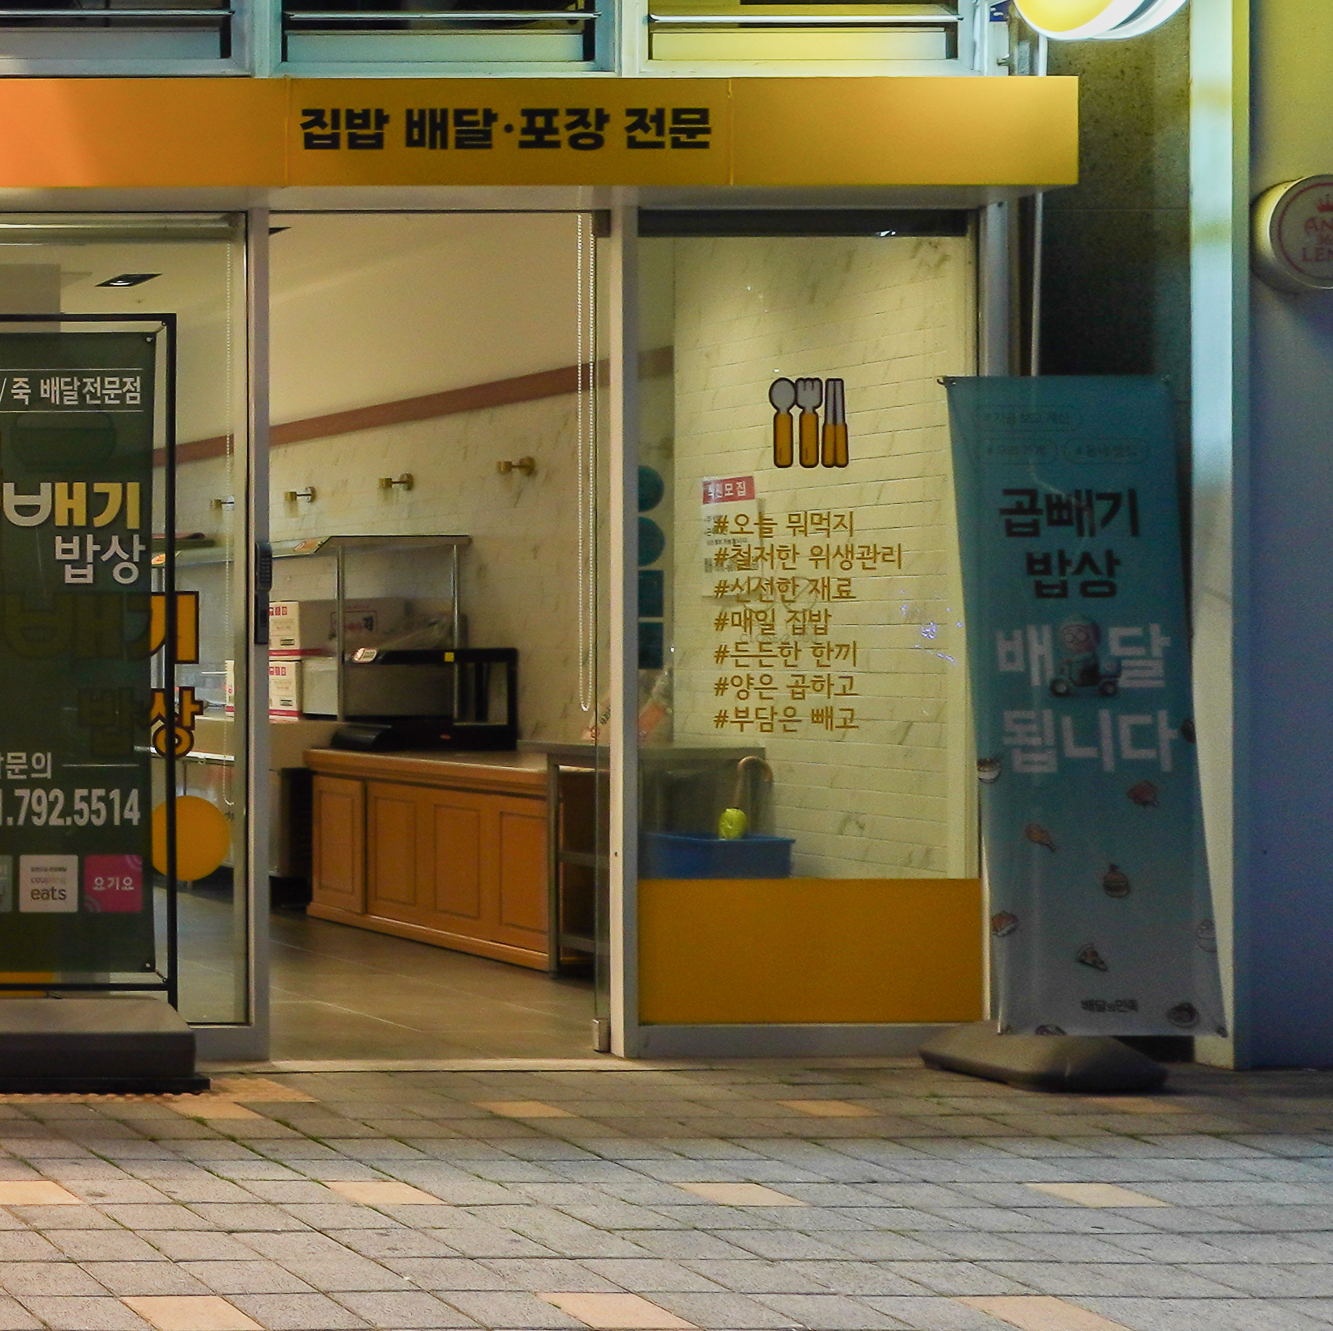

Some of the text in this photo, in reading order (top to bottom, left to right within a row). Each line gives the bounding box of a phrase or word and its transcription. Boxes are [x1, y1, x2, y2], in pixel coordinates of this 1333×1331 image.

[299, 106, 389, 151] 집밥
[624, 106, 714, 151] 전문
[54, 534, 146, 585] 밥상
[808, 543, 903, 570] 위생관리
[1025, 548, 1122, 599] 밥상
[808, 577, 857, 601] 재료
[786, 608, 833, 636] 집밥
[809, 640, 858, 667] 한끼
[786, 673, 859, 701] 곱하고
[810, 705, 859, 733] 빼고
[1001, 707, 1179, 774] 됩니다
[30, 887, 67, 901] eats
[92, 876, 135, 891] 요기요
